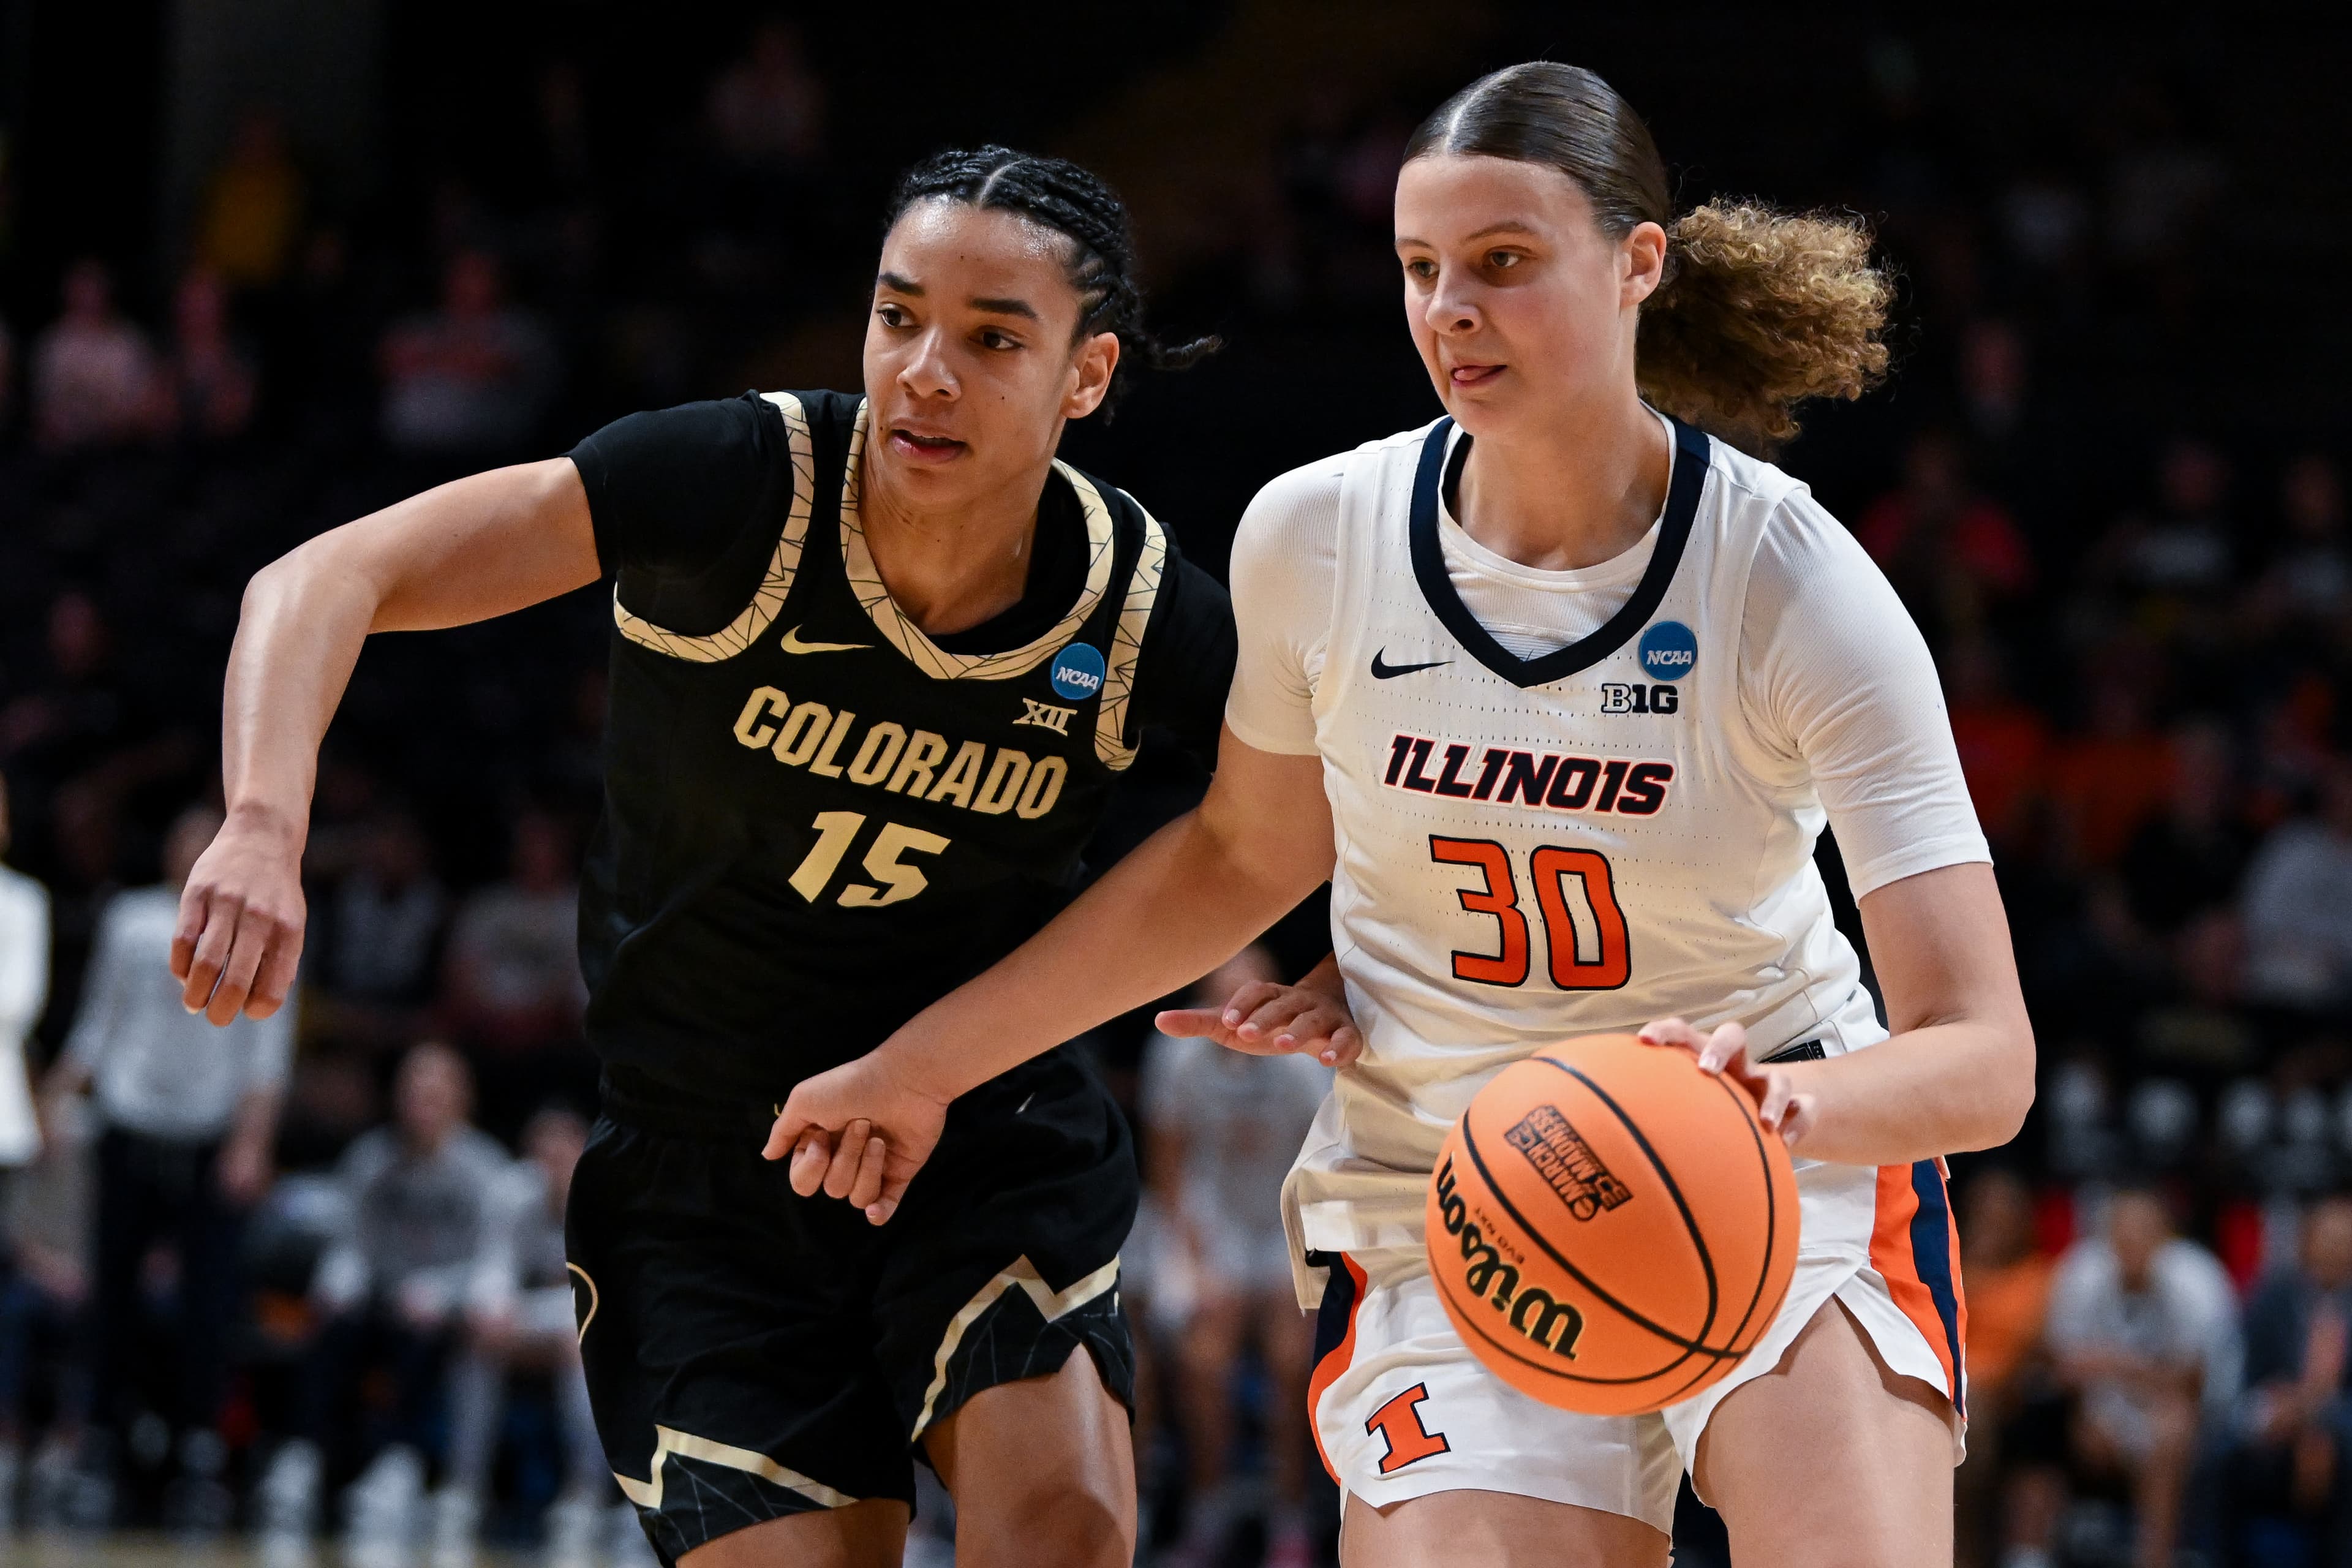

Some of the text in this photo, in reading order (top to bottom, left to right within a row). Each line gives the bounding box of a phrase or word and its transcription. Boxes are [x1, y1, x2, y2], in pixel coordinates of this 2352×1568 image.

[1055, 666, 1099, 690] NCAA
[1646, 650, 1692, 666] NCAA
[733, 685, 1068, 820] COLORADO
[1012, 698, 1078, 736] XII
[1383, 734, 1675, 816] ILLINOIS
[788, 810, 951, 908] 15
[1428, 834, 1632, 991] 30
[1526, 1140, 1586, 1203] MARCH
[1528, 1107, 1597, 1181] MADNESS
[1436, 1151, 1585, 1361] Wilson
[1365, 1382, 1451, 1474] I
